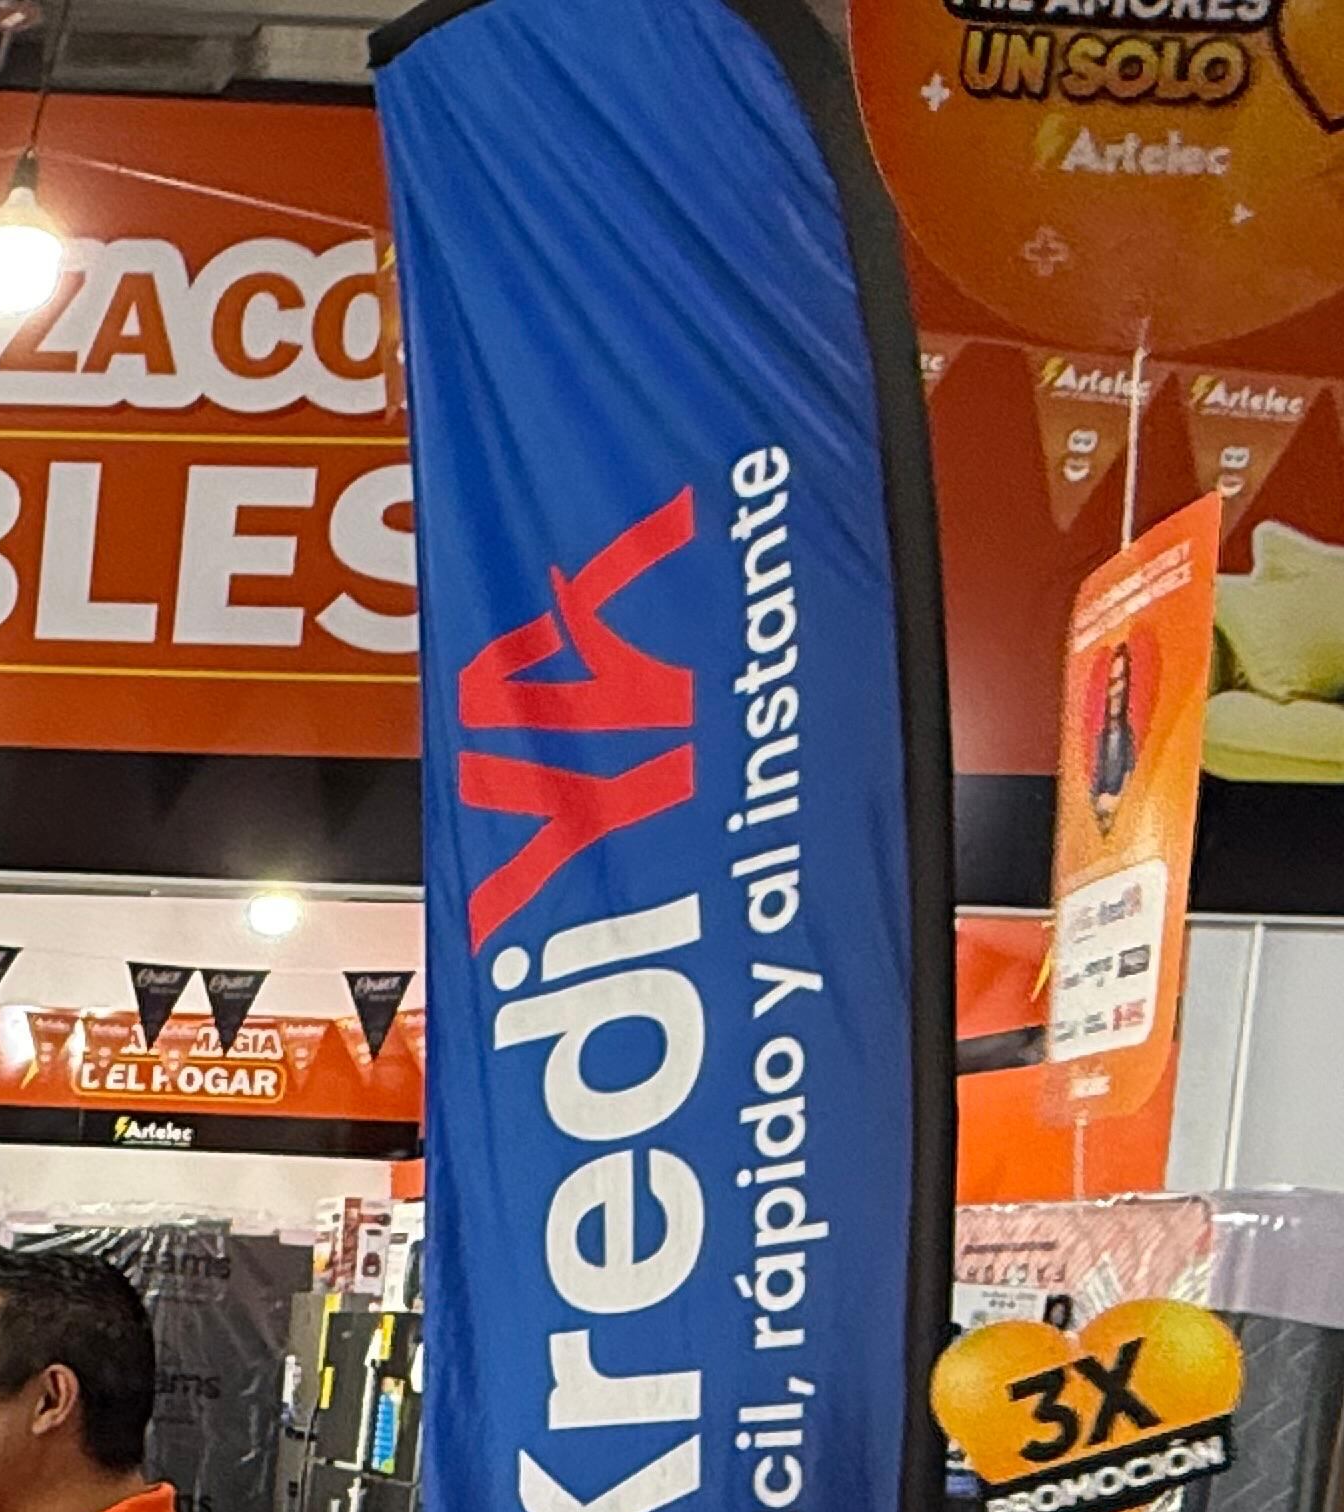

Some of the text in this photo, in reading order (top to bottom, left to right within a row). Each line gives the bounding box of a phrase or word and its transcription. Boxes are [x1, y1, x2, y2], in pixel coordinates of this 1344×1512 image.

[965, 28, 1250, 105] UN SOLO
[1062, 128, 1233, 177] Artelec
[1207, 381, 1305, 416] Artelec
[728, 444, 801, 832] instante
[730, 843, 801, 935] al
[752, 962, 823, 1019] y
[151, 1064, 279, 1097] HOGAR
[125, 1119, 193, 1142] Artelec
[734, 1034, 830, 1351] rápido
[1009, 1337, 1163, 1463] 3X
